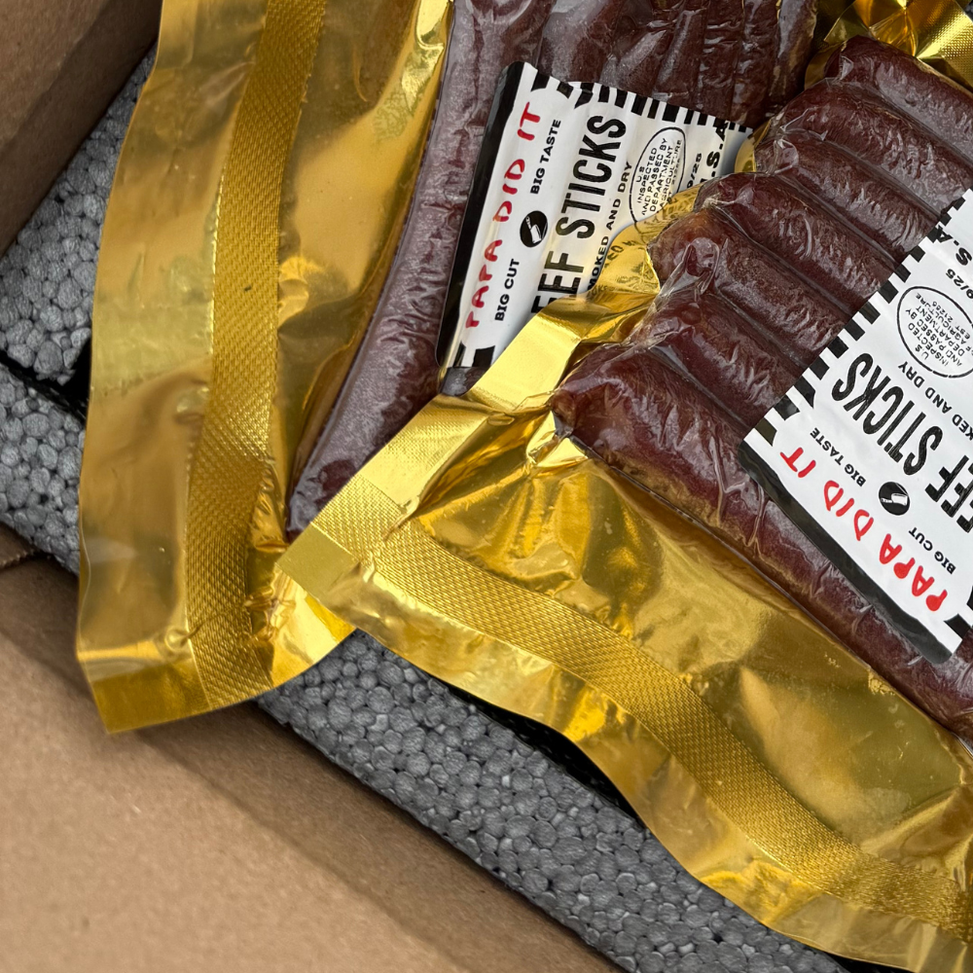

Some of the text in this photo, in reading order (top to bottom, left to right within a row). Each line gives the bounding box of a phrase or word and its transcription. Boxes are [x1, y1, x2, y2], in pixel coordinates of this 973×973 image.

[491, 155, 527, 224] DID
[515, 100, 544, 141] IT
[530, 119, 561, 194] BIG TASTE
[659, 138, 667, 151] BY
[555, 115, 626, 239] STICKS
[649, 146, 673, 212] DEPARTMENT
[585, 158, 633, 289] MOKED AND DRY
[494, 258, 520, 321] BIG CUT
[915, 293, 967, 345] AGRICULTURE
[905, 309, 962, 366] AND PASSED BY
[908, 322, 949, 366] INSPECTED
[915, 305, 965, 357] DEPARTMENT
[898, 361, 925, 388] DRY
[925, 387, 952, 414] AND
[831, 353, 943, 476] STICKS
[810, 427, 866, 487] BIG TASTE
[780, 447, 948, 612] PAPA DID IT
[908, 527, 956, 575] BIG CUT
